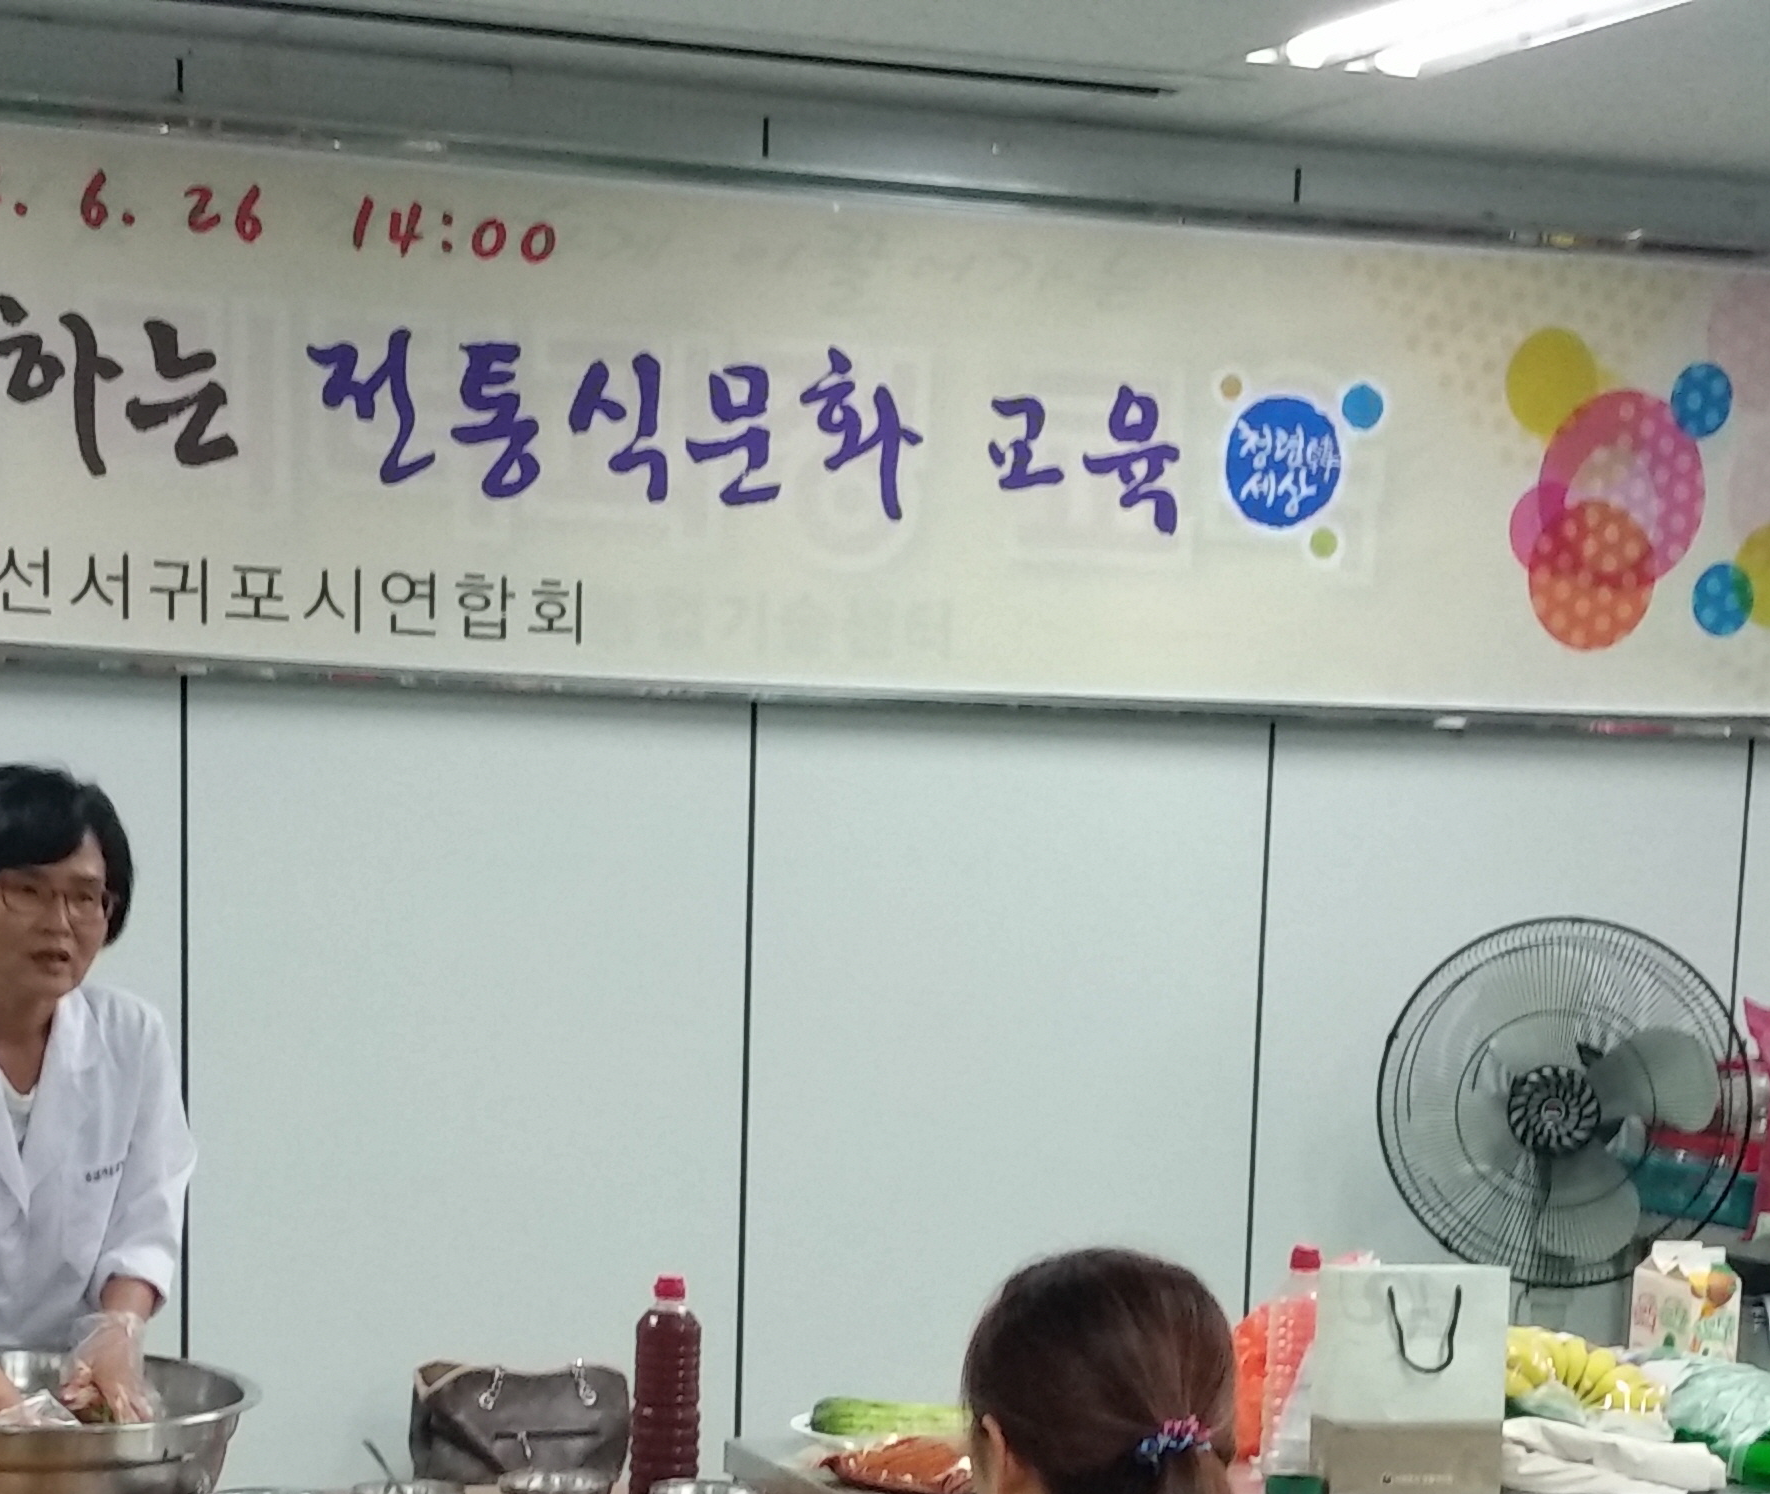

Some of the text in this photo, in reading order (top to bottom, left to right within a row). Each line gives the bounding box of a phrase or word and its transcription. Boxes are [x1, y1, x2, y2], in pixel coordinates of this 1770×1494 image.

[79, 170, 136, 229] 6.
[185, 185, 263, 243] 26
[352, 195, 557, 263] 14:00
[307, 328, 922, 521] 전통식문화
[988, 386, 1180, 535] 교육
[1239, 467, 1317, 518] 세상
